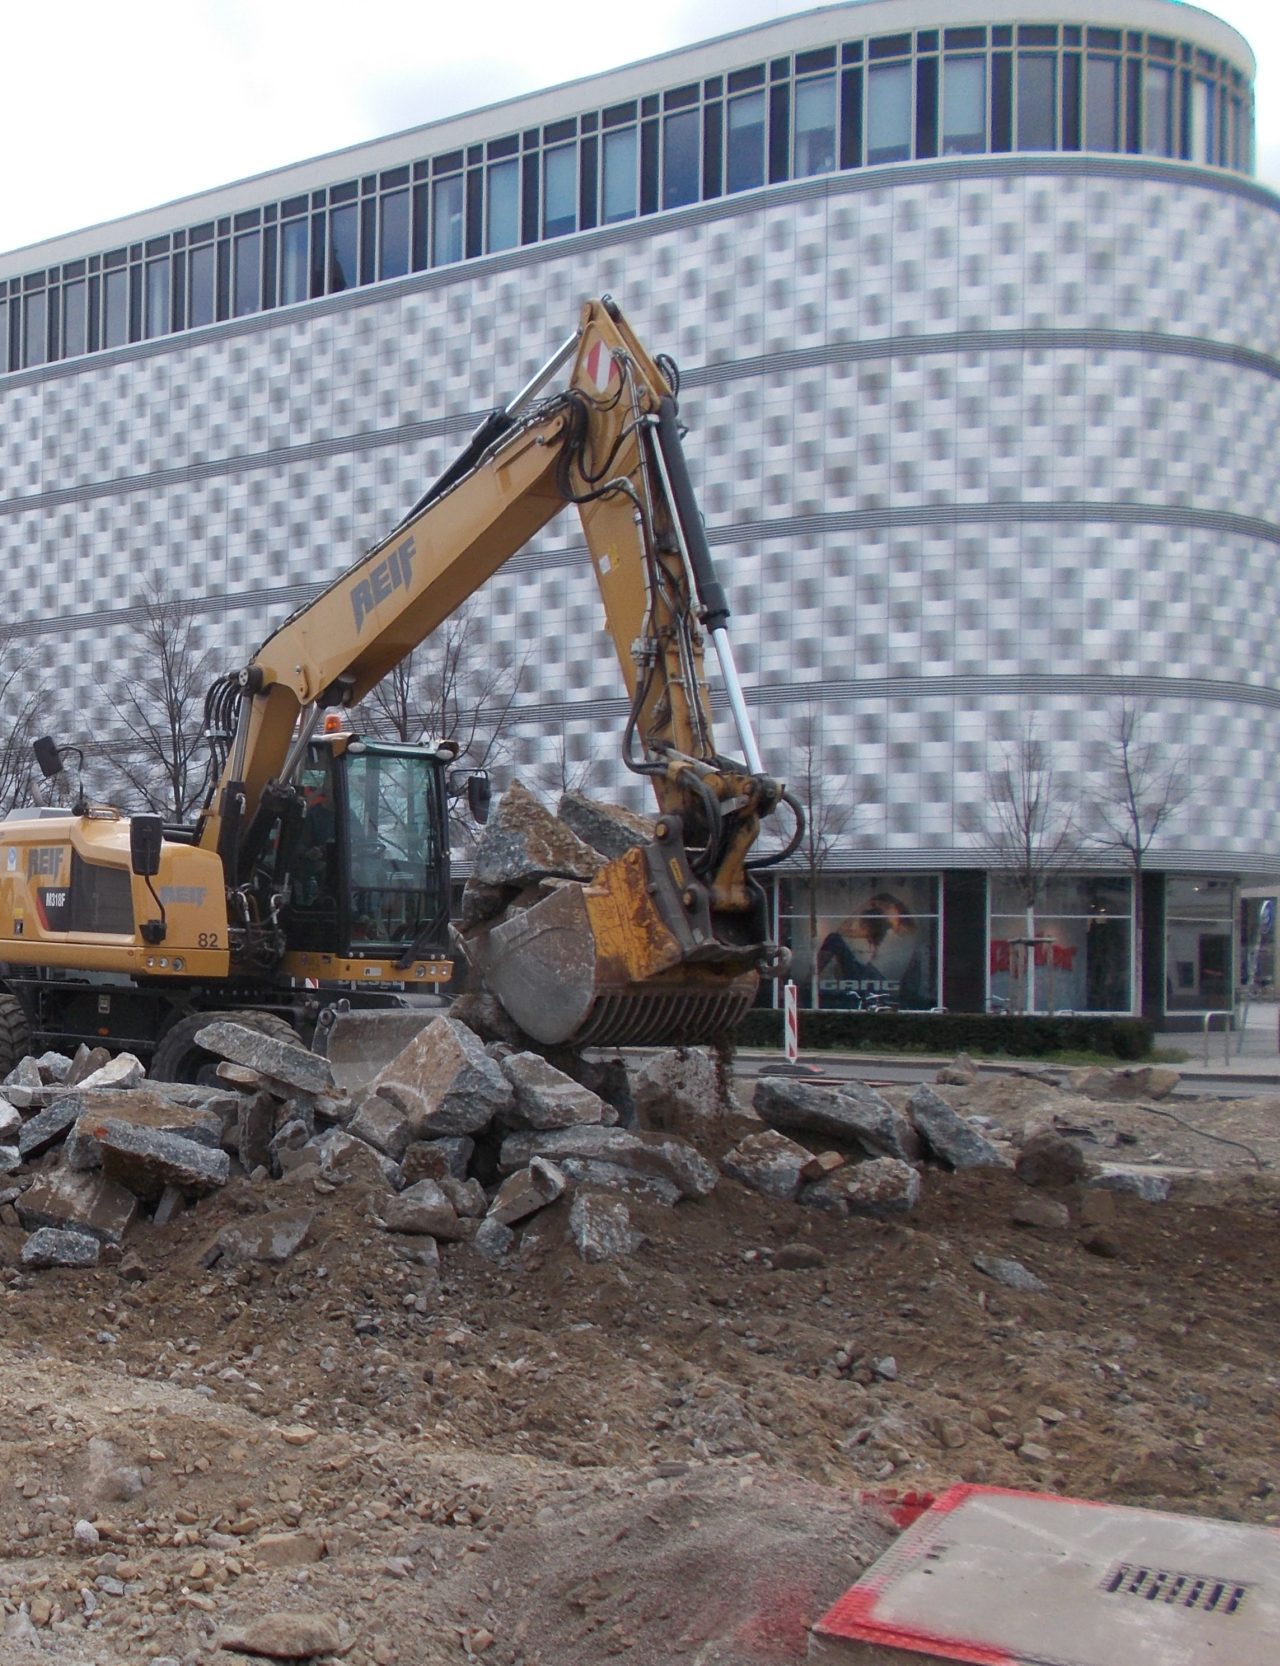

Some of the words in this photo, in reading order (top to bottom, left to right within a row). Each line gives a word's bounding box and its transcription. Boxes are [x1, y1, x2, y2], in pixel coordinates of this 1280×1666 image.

[350, 535, 417, 634] REIF
[26, 847, 64, 885] REIF
[45, 892, 66, 907] M318F
[160, 886, 208, 908] REIF
[198, 932, 218, 948] 82
[821, 979, 901, 991] GANG
